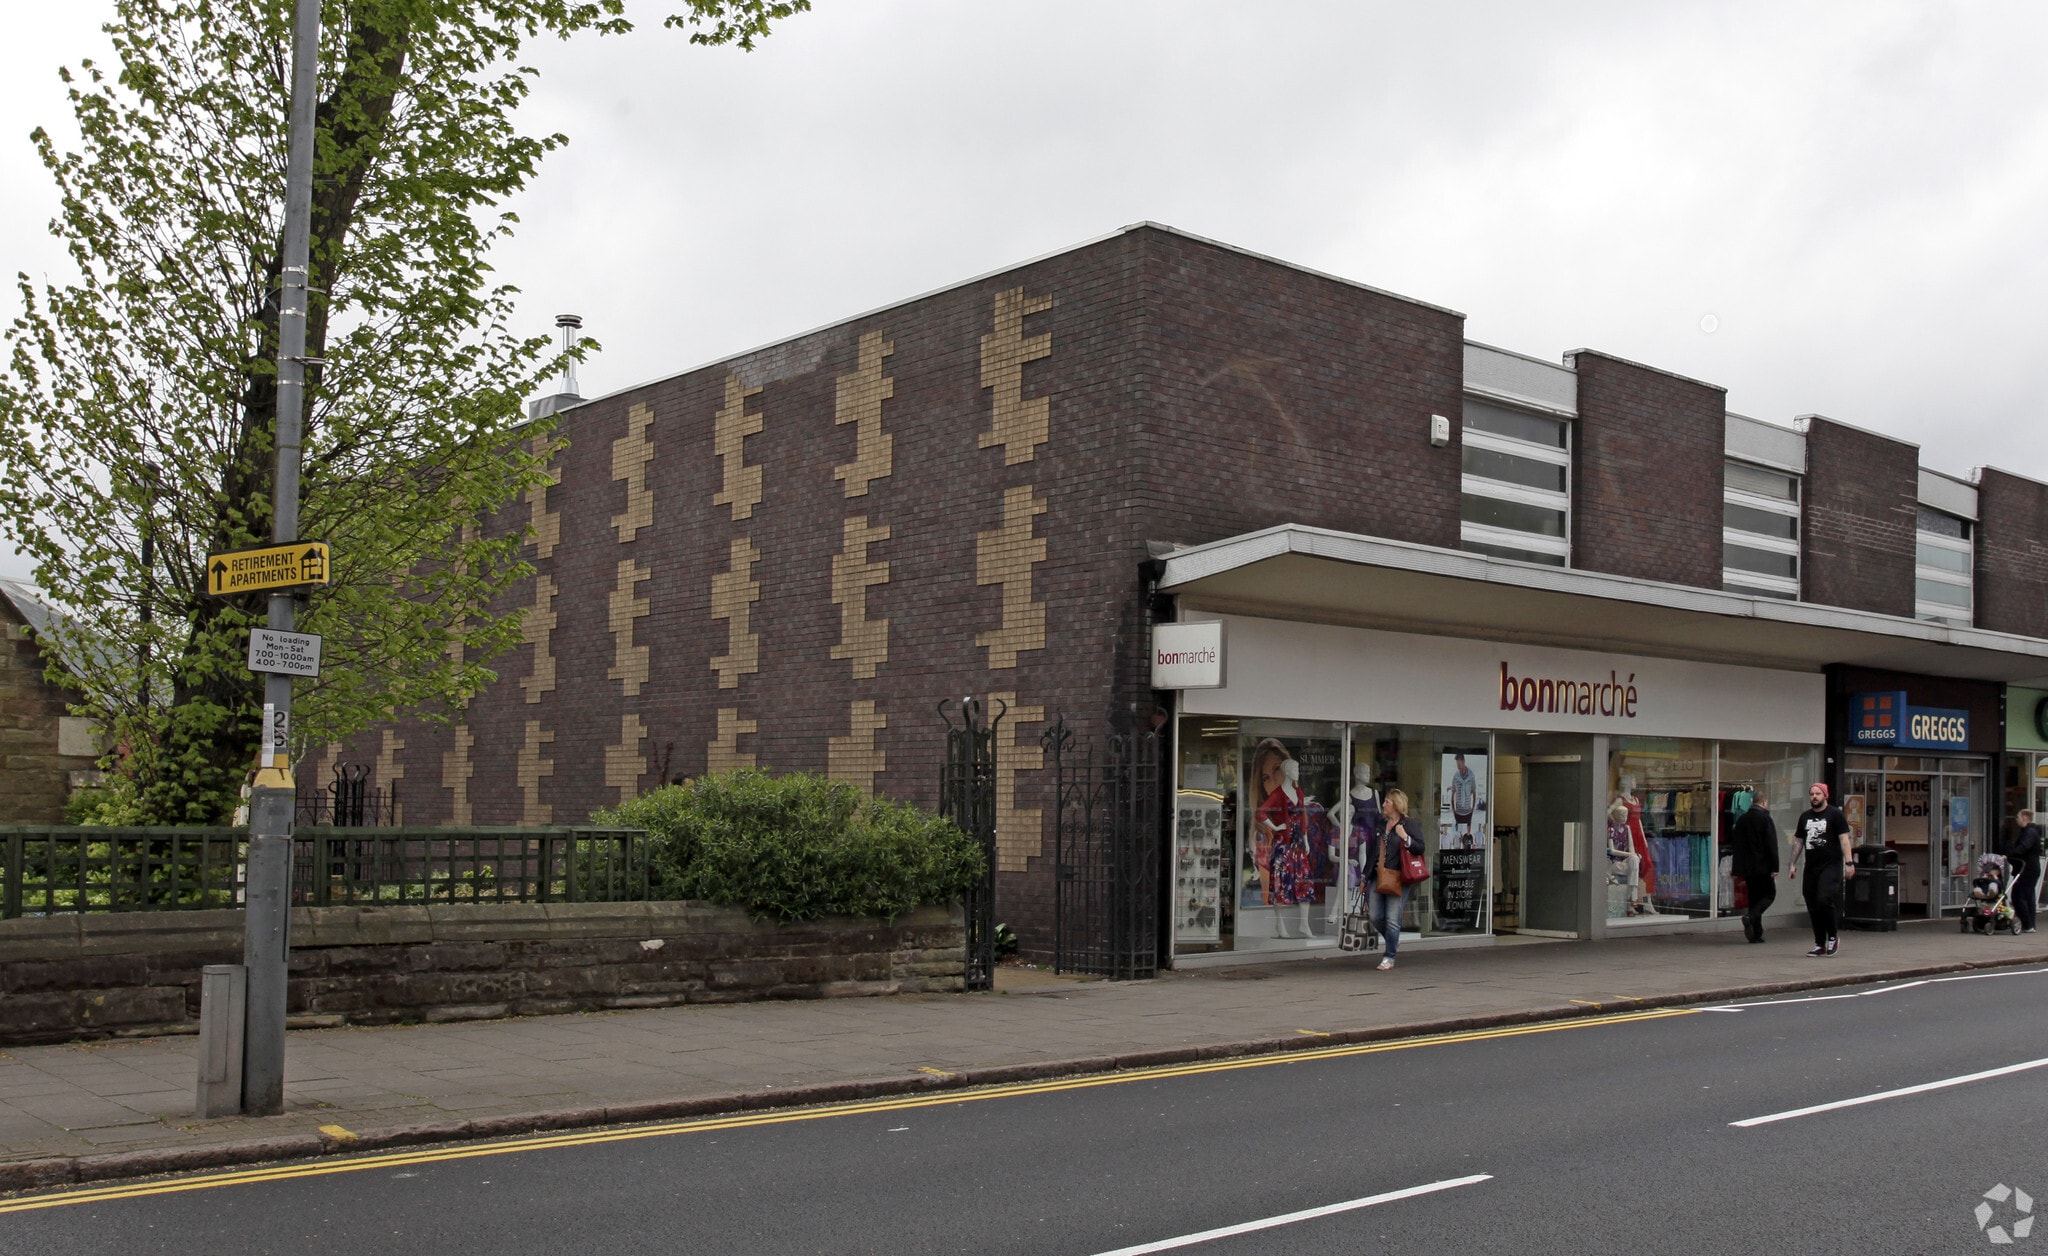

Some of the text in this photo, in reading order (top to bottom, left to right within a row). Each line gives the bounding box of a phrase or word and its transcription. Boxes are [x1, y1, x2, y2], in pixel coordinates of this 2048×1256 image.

[232, 552, 294, 572] RETIREMENT
[230, 567, 297, 587] APARTMENTS
[280, 636, 310, 647] loading
[1157, 646, 1216, 665] bonmarché
[1500, 661, 1637, 718] bonmarché
[1911, 714, 1966, 742] GREGGS
[1858, 729, 1896, 739] GREGGS
[1300, 755, 1335, 764] SUMMER
[1852, 776, 1930, 792] Wecome
[1442, 855, 1481, 865] MENSWEAR
[1447, 880, 1475, 888] AVAILABLE
[1456, 891, 1473, 899] STORE
[1452, 901, 1472, 909] ONLINE
